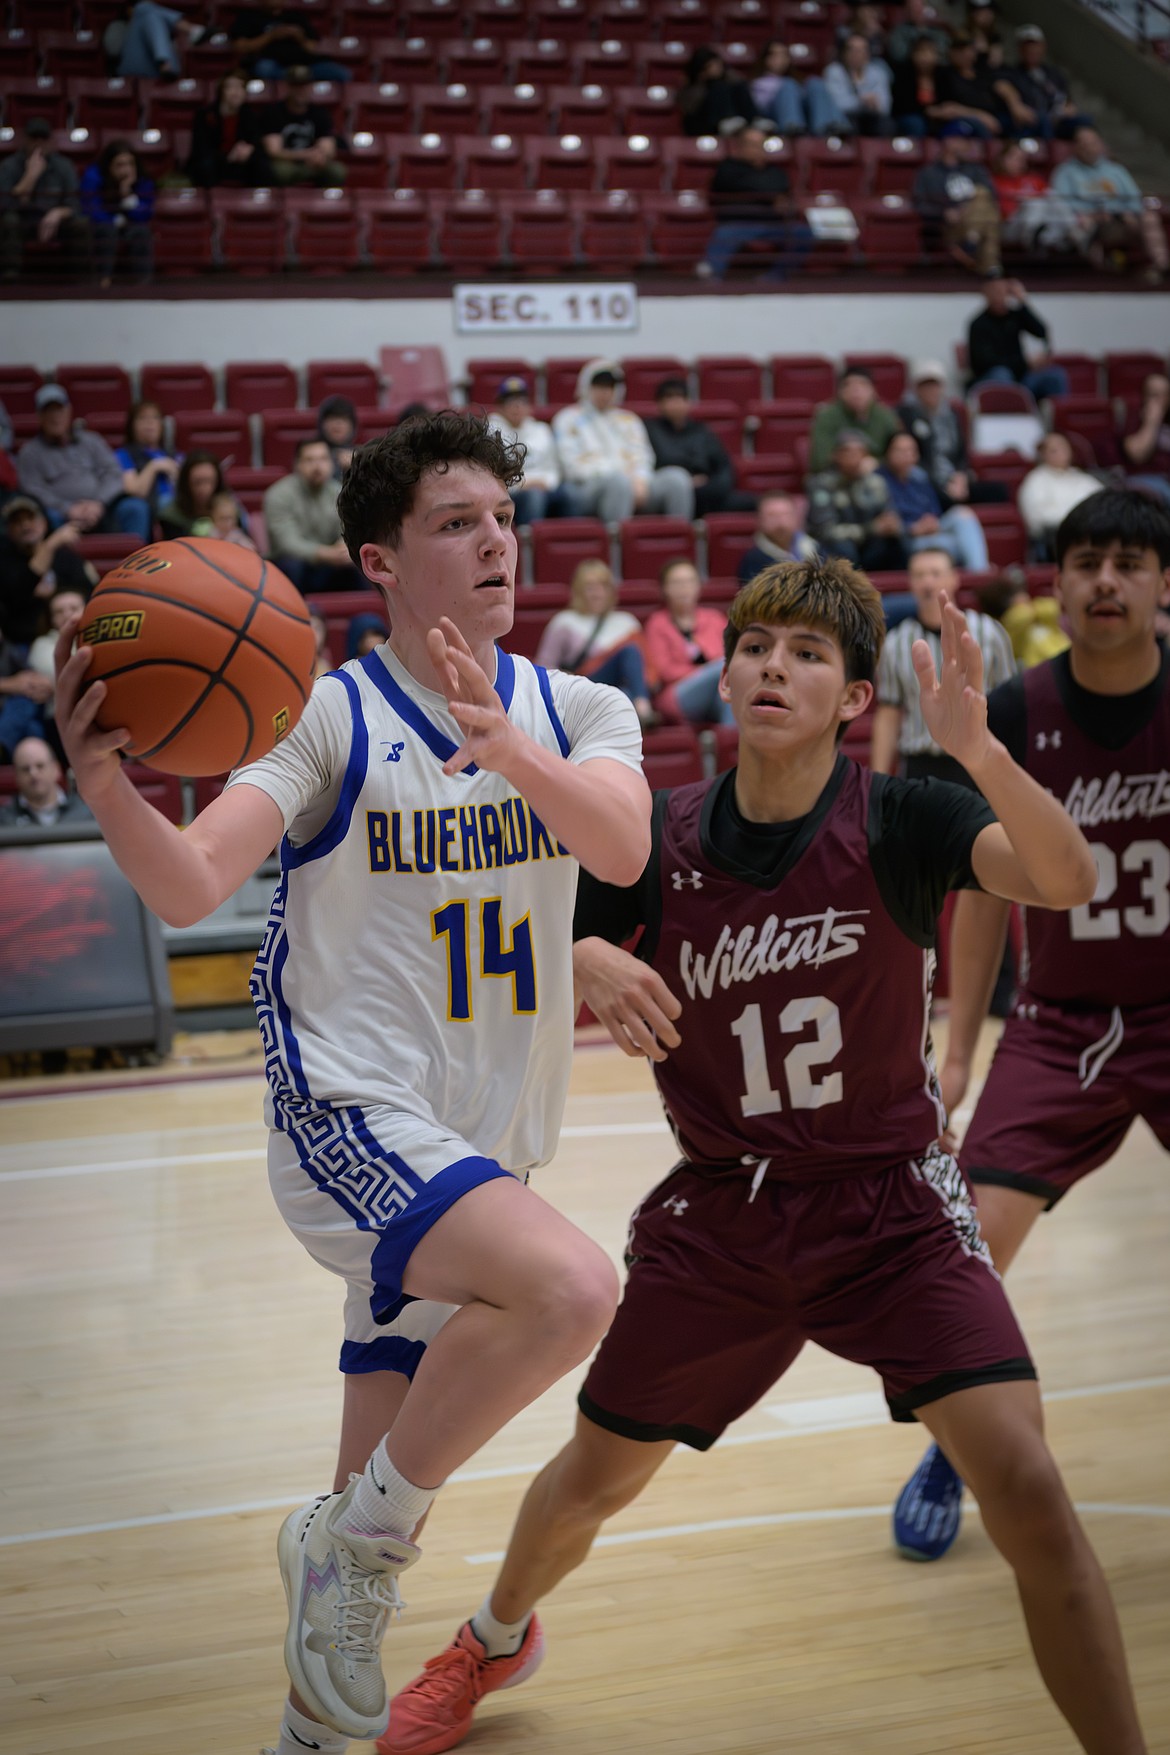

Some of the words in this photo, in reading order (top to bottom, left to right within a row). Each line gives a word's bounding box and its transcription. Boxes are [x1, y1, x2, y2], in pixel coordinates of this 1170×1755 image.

[464, 294, 552, 321] SEC.
[565, 294, 630, 321] 110
[366, 797, 573, 874] BLUEHAWK
[1069, 838, 1170, 941] 23
[430, 896, 538, 1022] 14
[680, 906, 871, 1000] Wildcats
[730, 996, 843, 1118] 12
